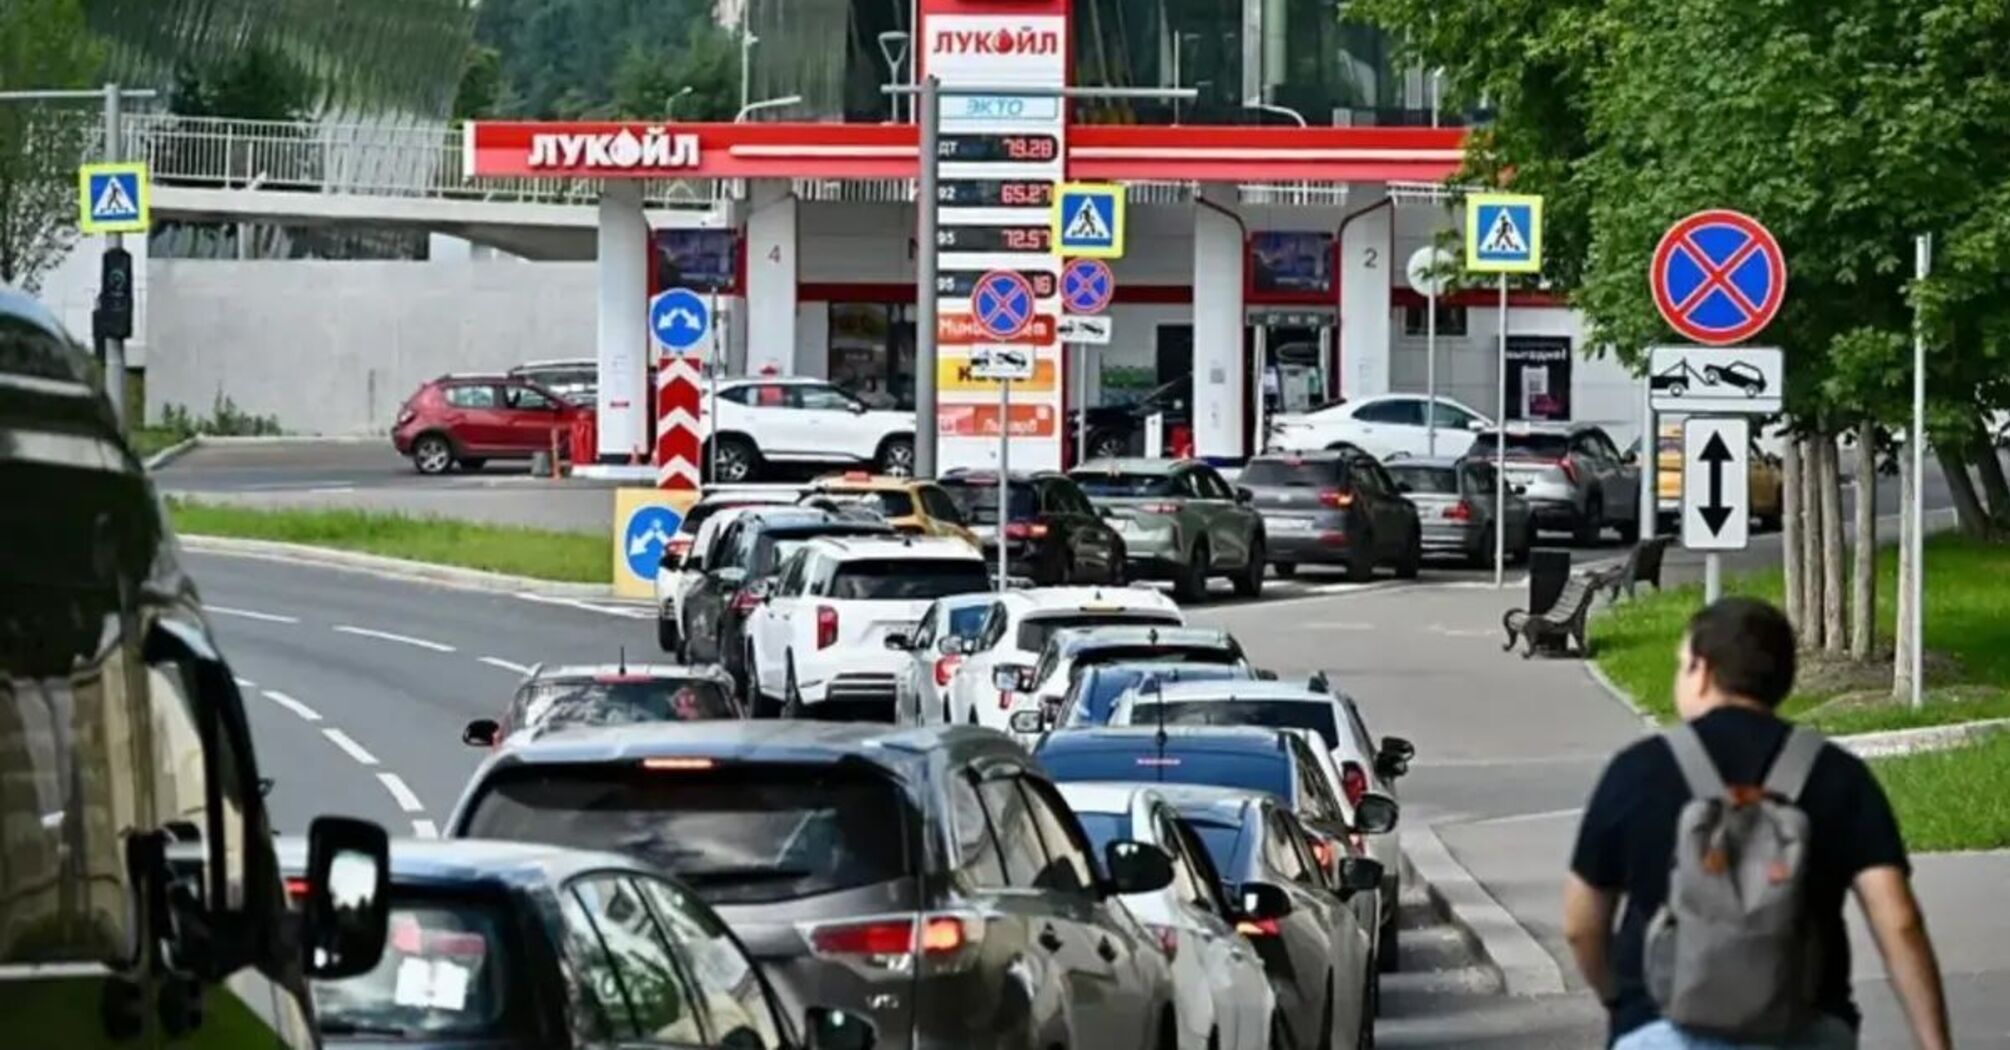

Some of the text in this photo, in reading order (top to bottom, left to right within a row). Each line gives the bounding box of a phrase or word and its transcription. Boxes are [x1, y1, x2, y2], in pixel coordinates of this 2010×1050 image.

[934, 26, 1057, 54] ЛУКОЙЛ
[967, 98, 1024, 116] ЭКТО
[528, 126, 699, 167] ЛУКОЙЛ
[939, 141, 958, 156] ДТ
[938, 186, 956, 200] 92
[768, 244, 781, 264] 4
[1364, 247, 1378, 269] 2
[937, 276, 954, 291] 95
